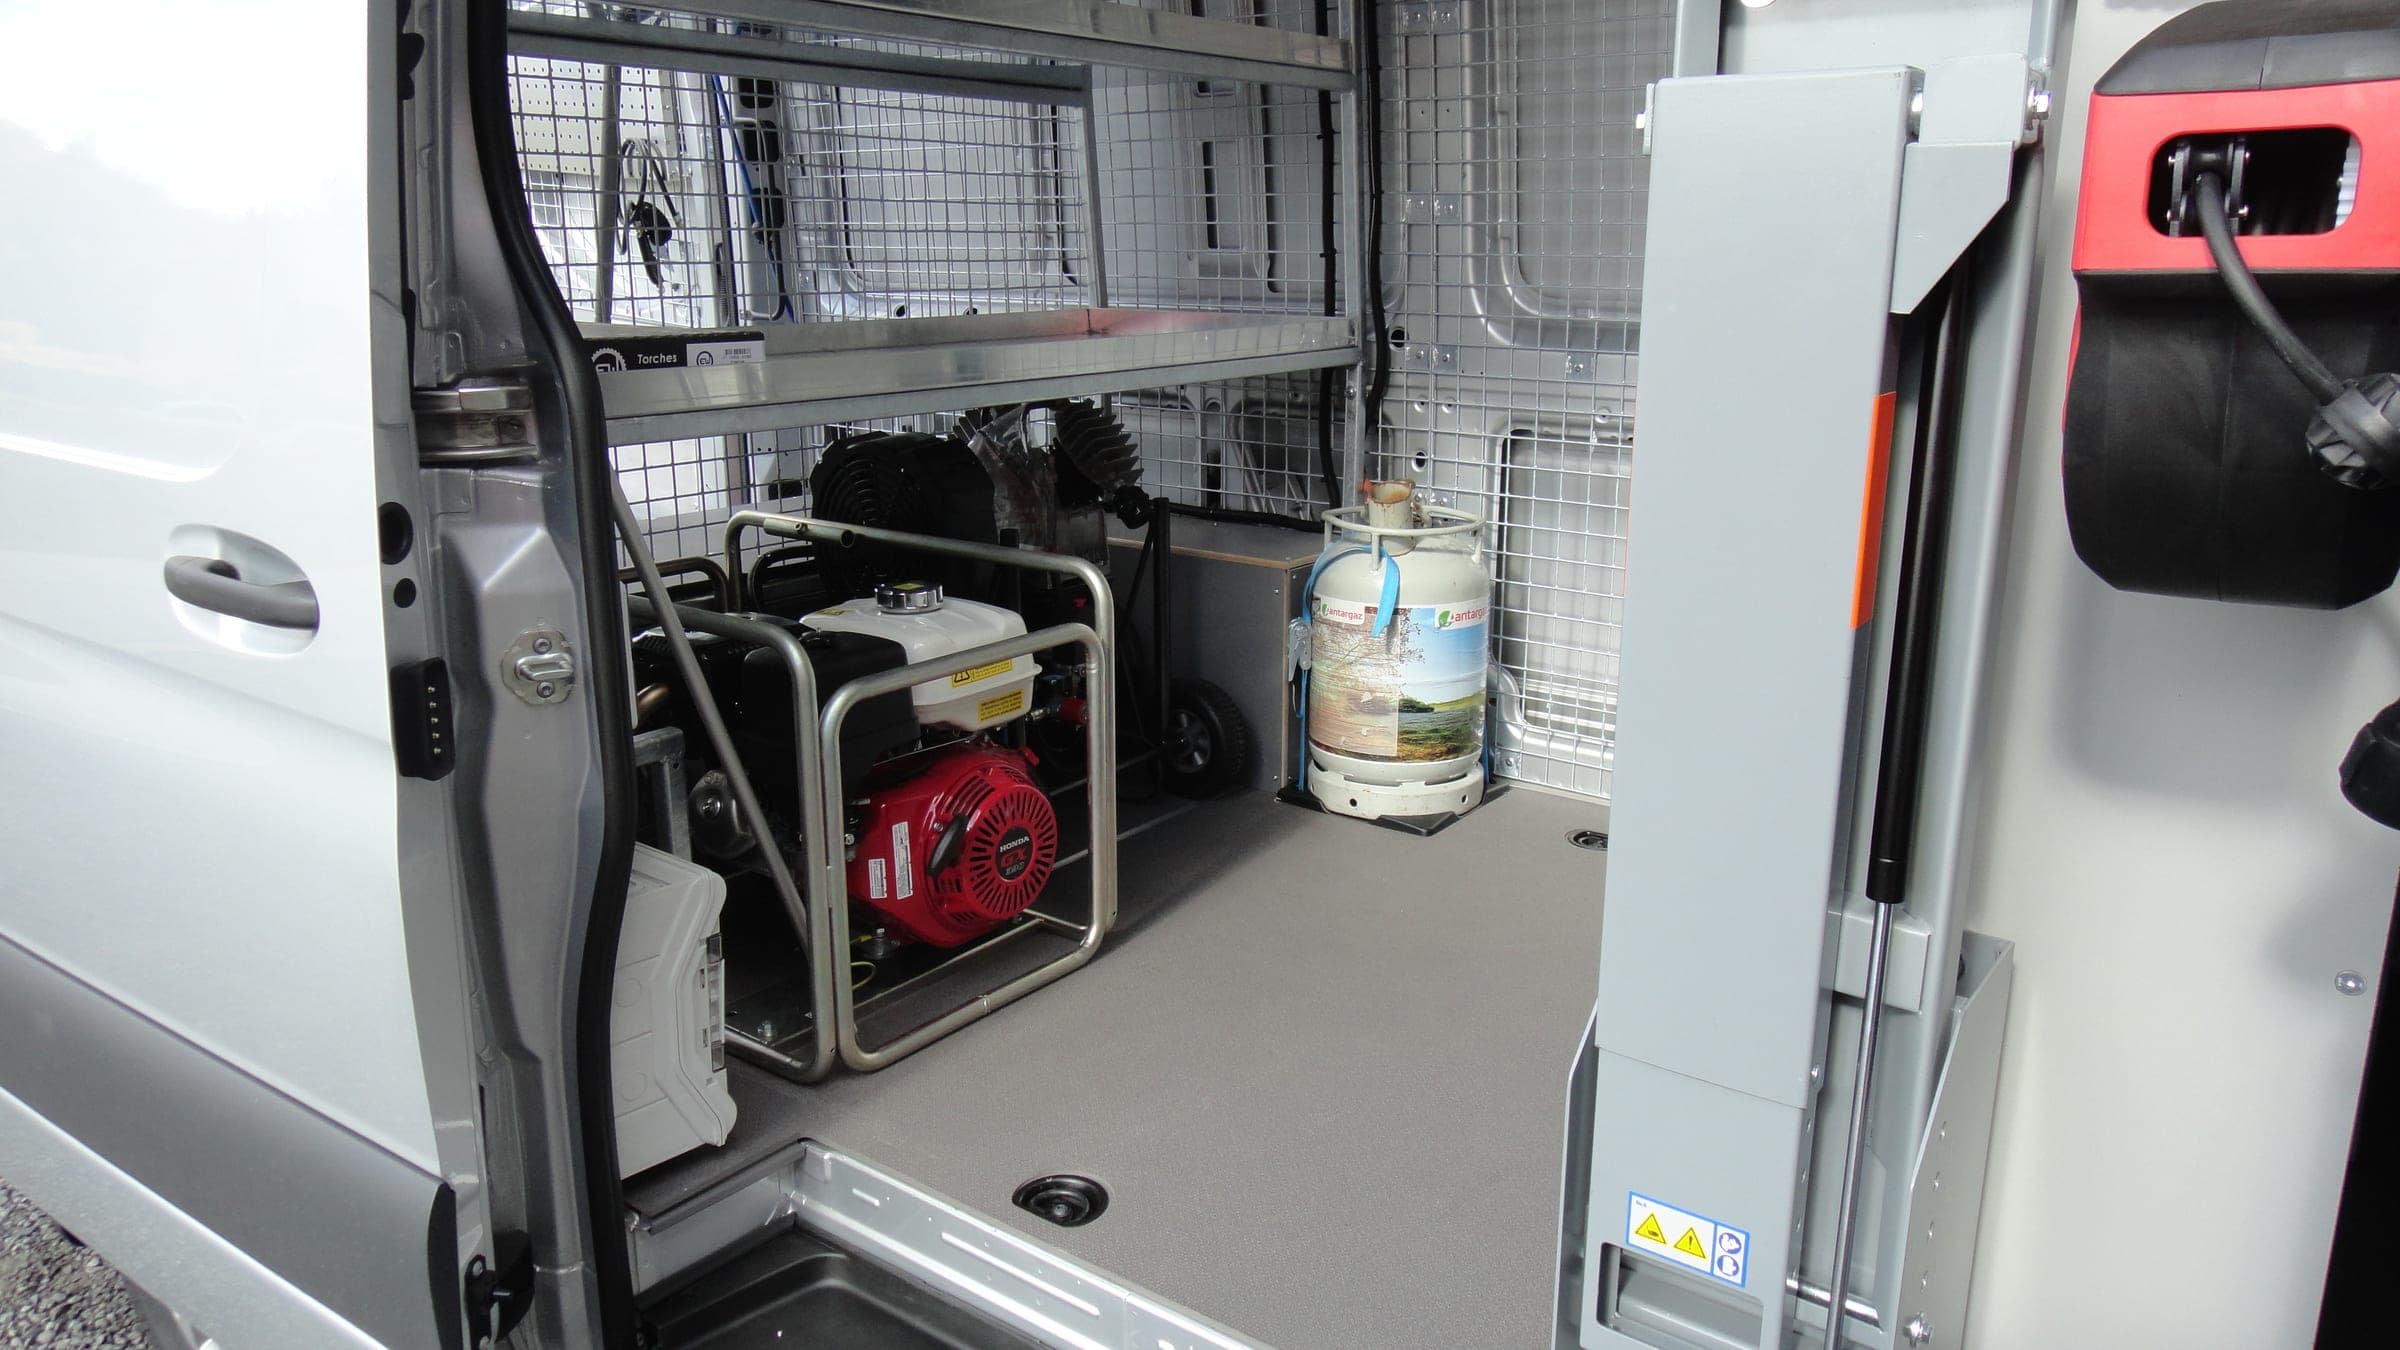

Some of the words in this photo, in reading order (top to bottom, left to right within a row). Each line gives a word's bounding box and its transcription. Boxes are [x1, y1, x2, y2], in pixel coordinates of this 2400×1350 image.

[637, 353, 677, 364] Torches
[1329, 608, 1363, 620] antargaz
[1000, 836, 1030, 853] HONDA
